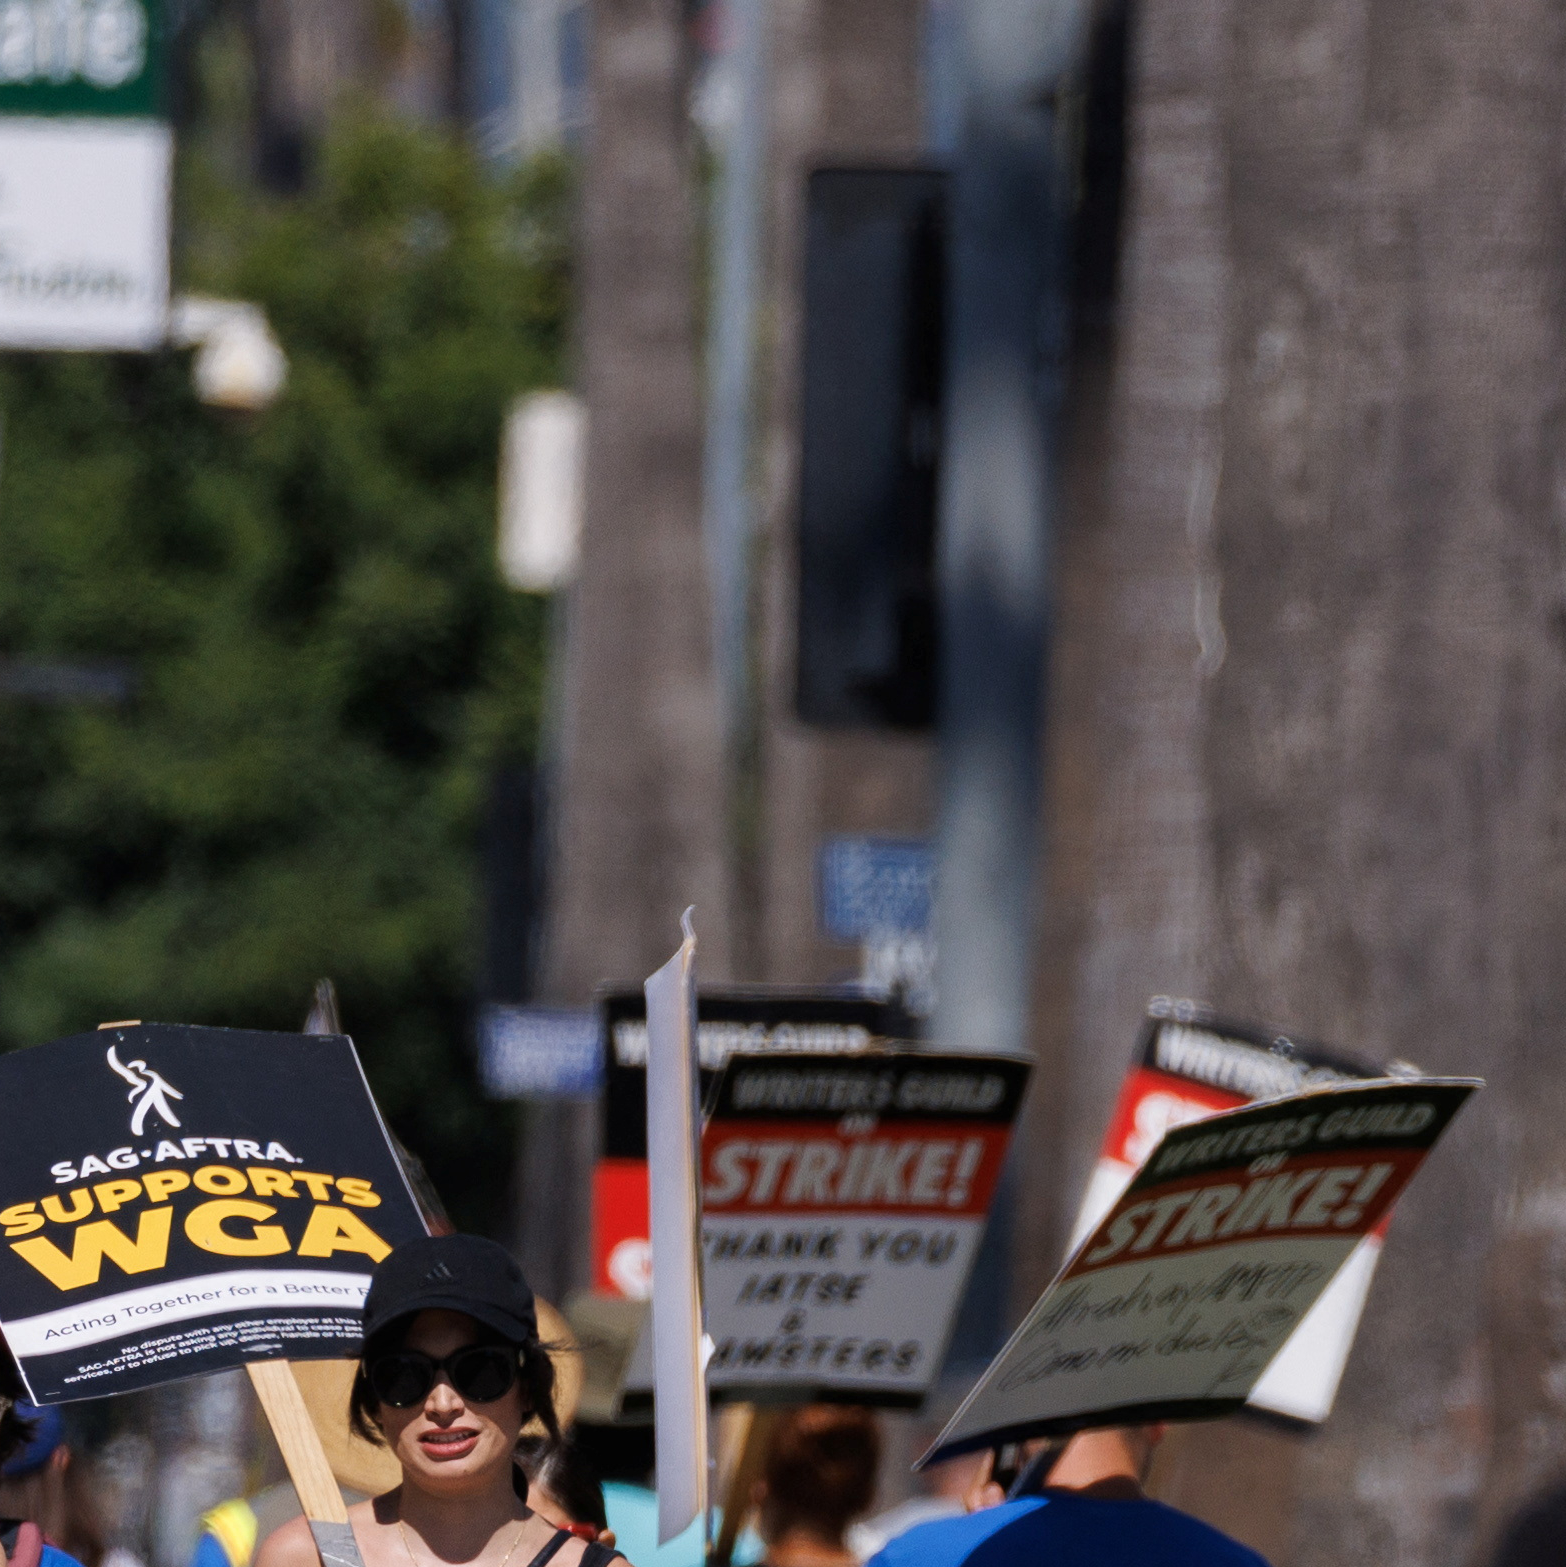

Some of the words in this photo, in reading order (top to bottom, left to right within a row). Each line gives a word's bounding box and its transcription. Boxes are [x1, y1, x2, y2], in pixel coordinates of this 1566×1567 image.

[1152, 1113, 1314, 1175] WRITERS
[1317, 1102, 1437, 1141] GUILD
[702, 1138, 983, 1208] STRIKE!
[1246, 1150, 1290, 1177] ON
[1084, 1161, 1395, 1264] STRIKE!
[9, 1199, 394, 1292] WGA
[858, 1229, 958, 1268] YOU
[736, 1272, 870, 1307] IATSE
[45, 1312, 117, 1340] Acting
[121, 1288, 222, 1318] Together
[228, 1283, 258, 1297] for
[266, 1286, 277, 1294] a
[284, 1283, 351, 1296] Better
[78, 1352, 144, 1374] SAG-AFTRA
[157, 1343, 177, 1353] not
[178, 1335, 217, 1348] asking
[217, 1331, 239, 1340] any
[120, 1345, 139, 1355] No
[140, 1334, 183, 1351] dispute
[184, 1328, 211, 1339] with
[212, 1325, 233, 1333] any
[709, 1336, 921, 1375] AMSTERS
[64, 1369, 113, 1384] services,
[142, 1351, 178, 1364] refuse
[179, 1347, 192, 1355] to
[193, 1342, 218, 1353] pick
